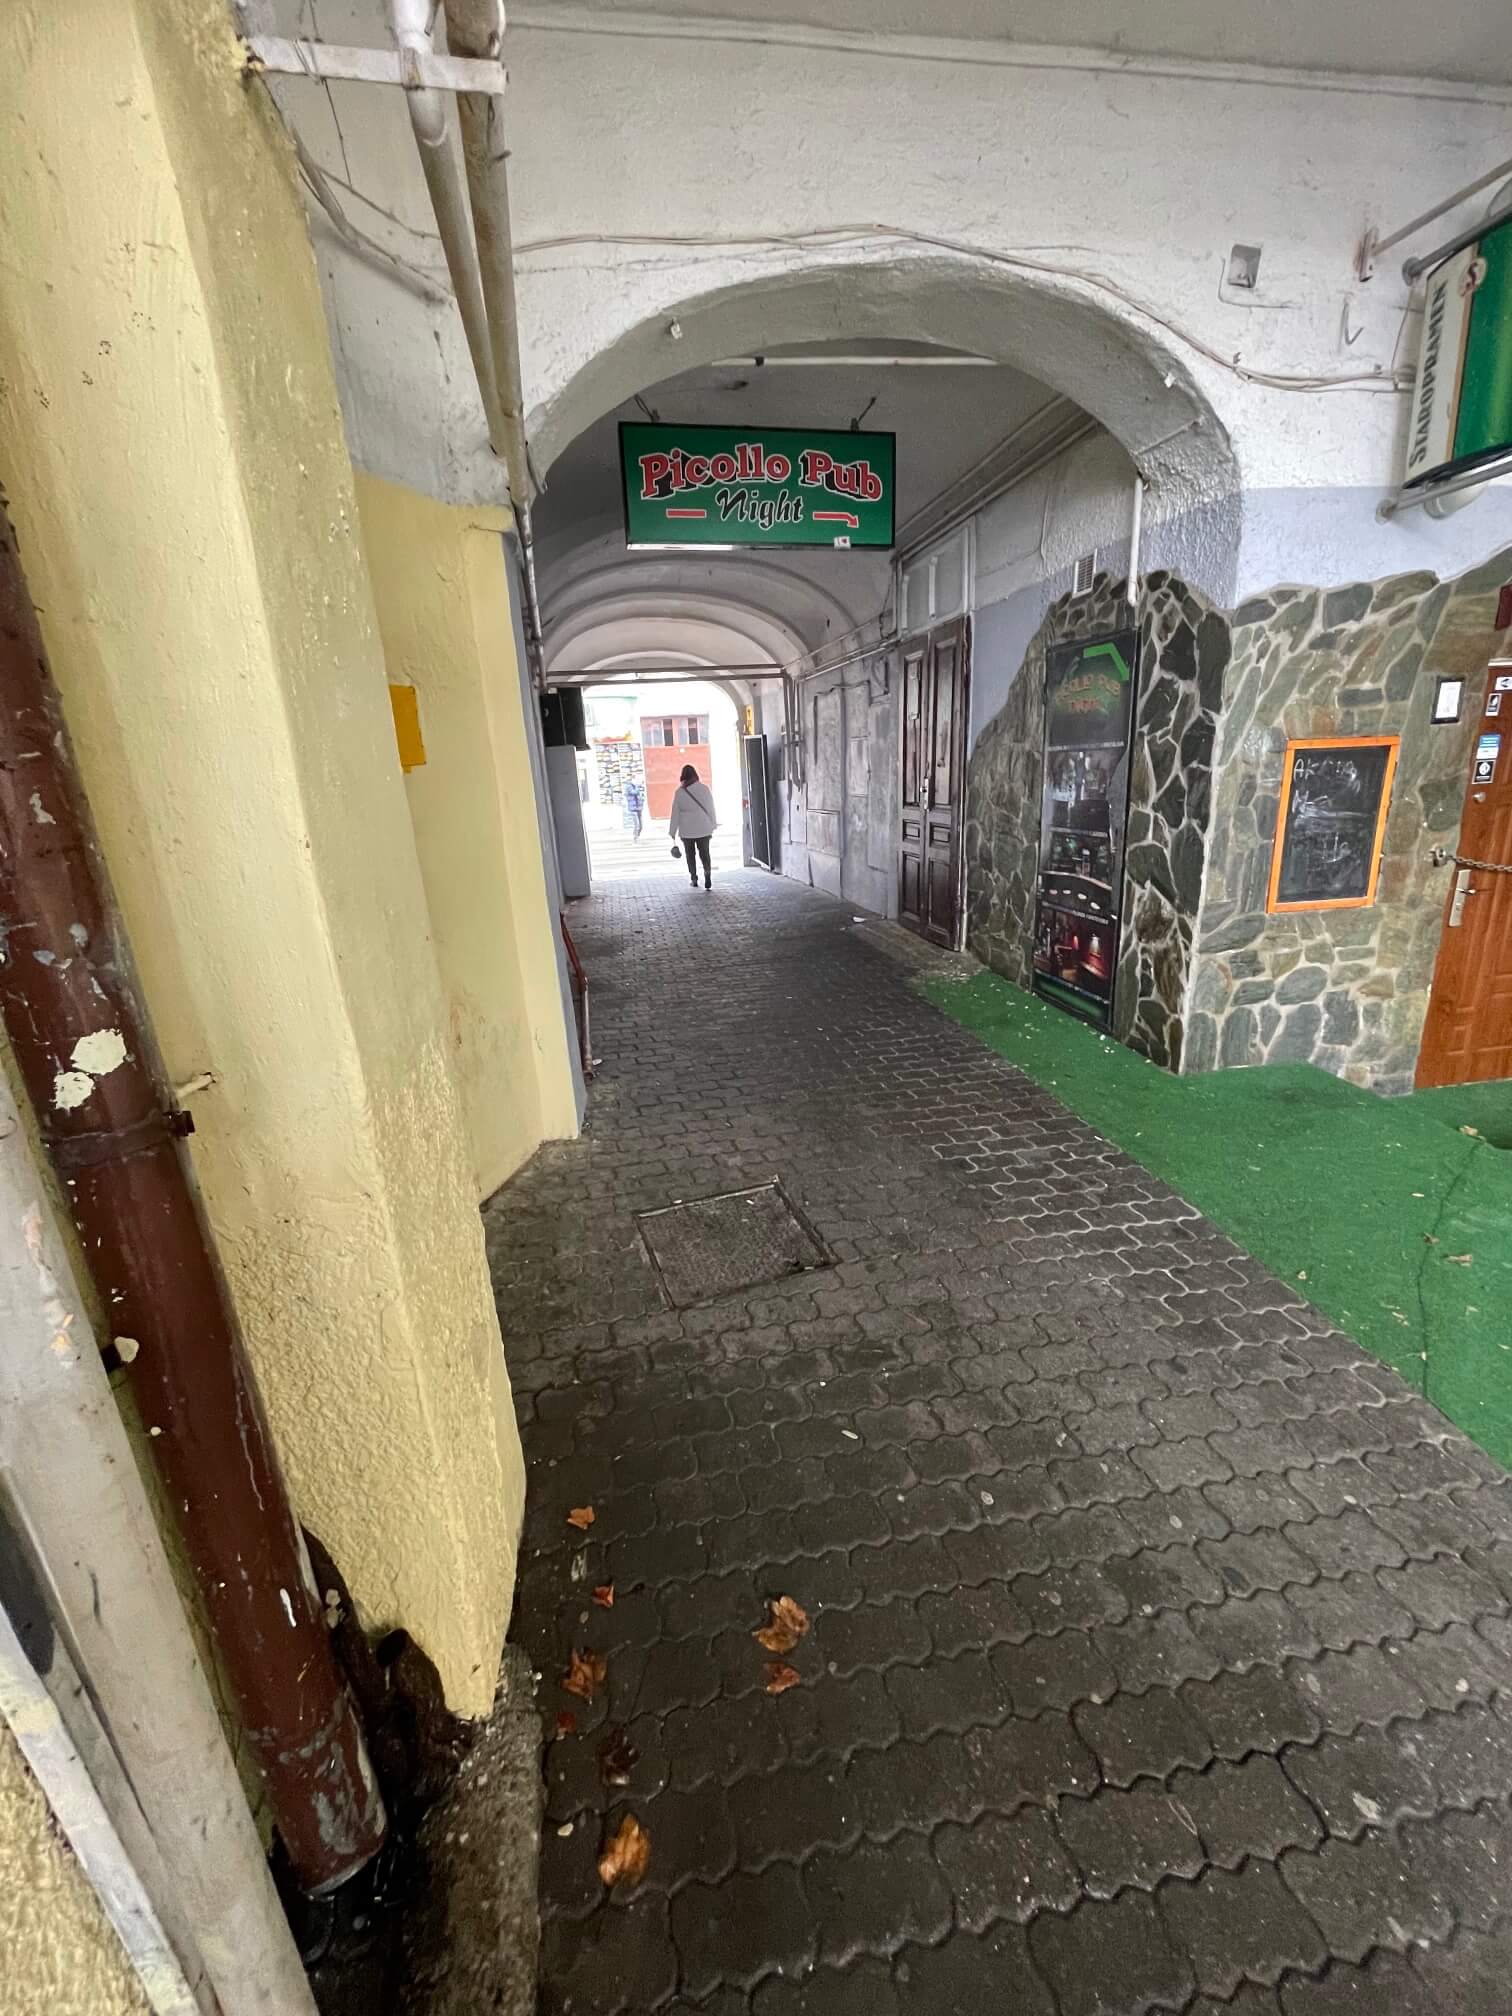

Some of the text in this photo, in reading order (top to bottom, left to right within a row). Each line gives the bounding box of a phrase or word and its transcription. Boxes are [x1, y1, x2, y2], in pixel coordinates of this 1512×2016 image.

[639, 443, 883, 501] Picollo Pub
[715, 488, 804, 531] Night
